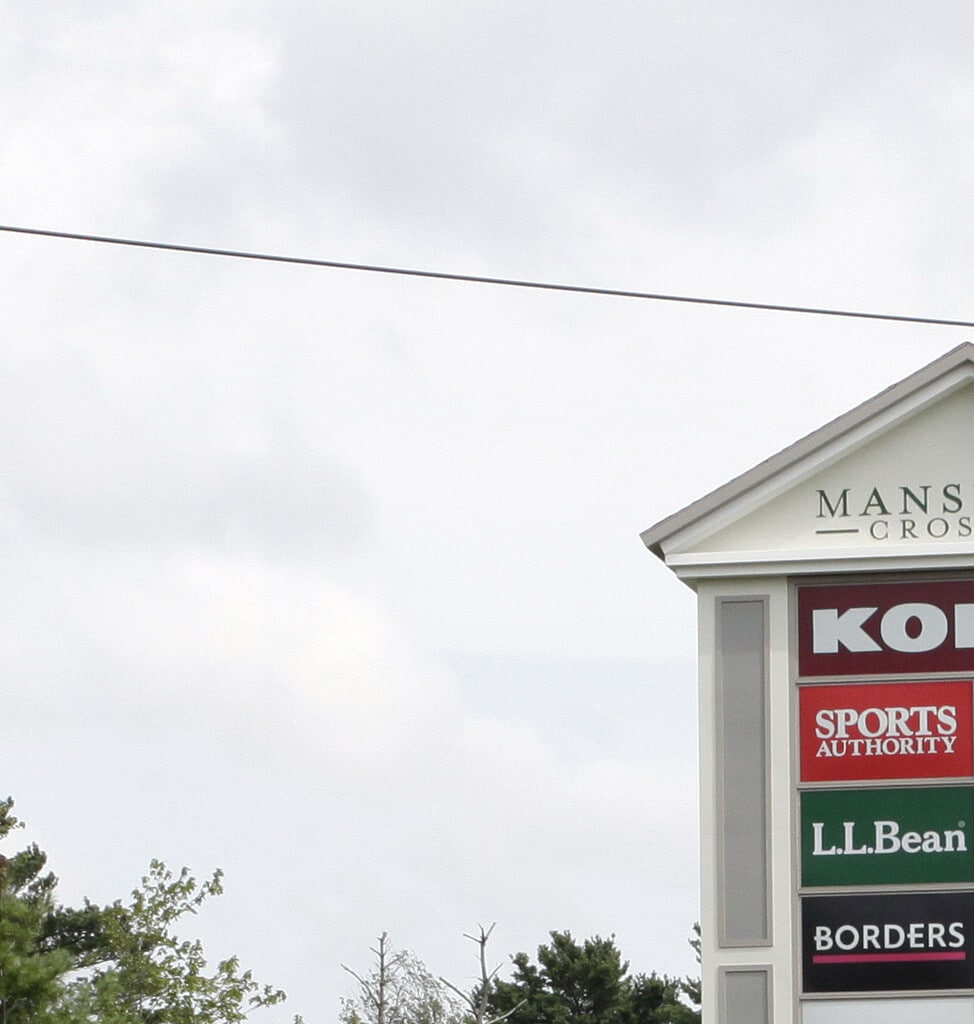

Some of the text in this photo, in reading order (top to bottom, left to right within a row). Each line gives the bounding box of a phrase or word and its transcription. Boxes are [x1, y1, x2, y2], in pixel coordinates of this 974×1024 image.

[815, 705, 958, 739] SPORTS
[815, 735, 957, 758] AUTHORITY
[814, 921, 966, 951] BORDERS
